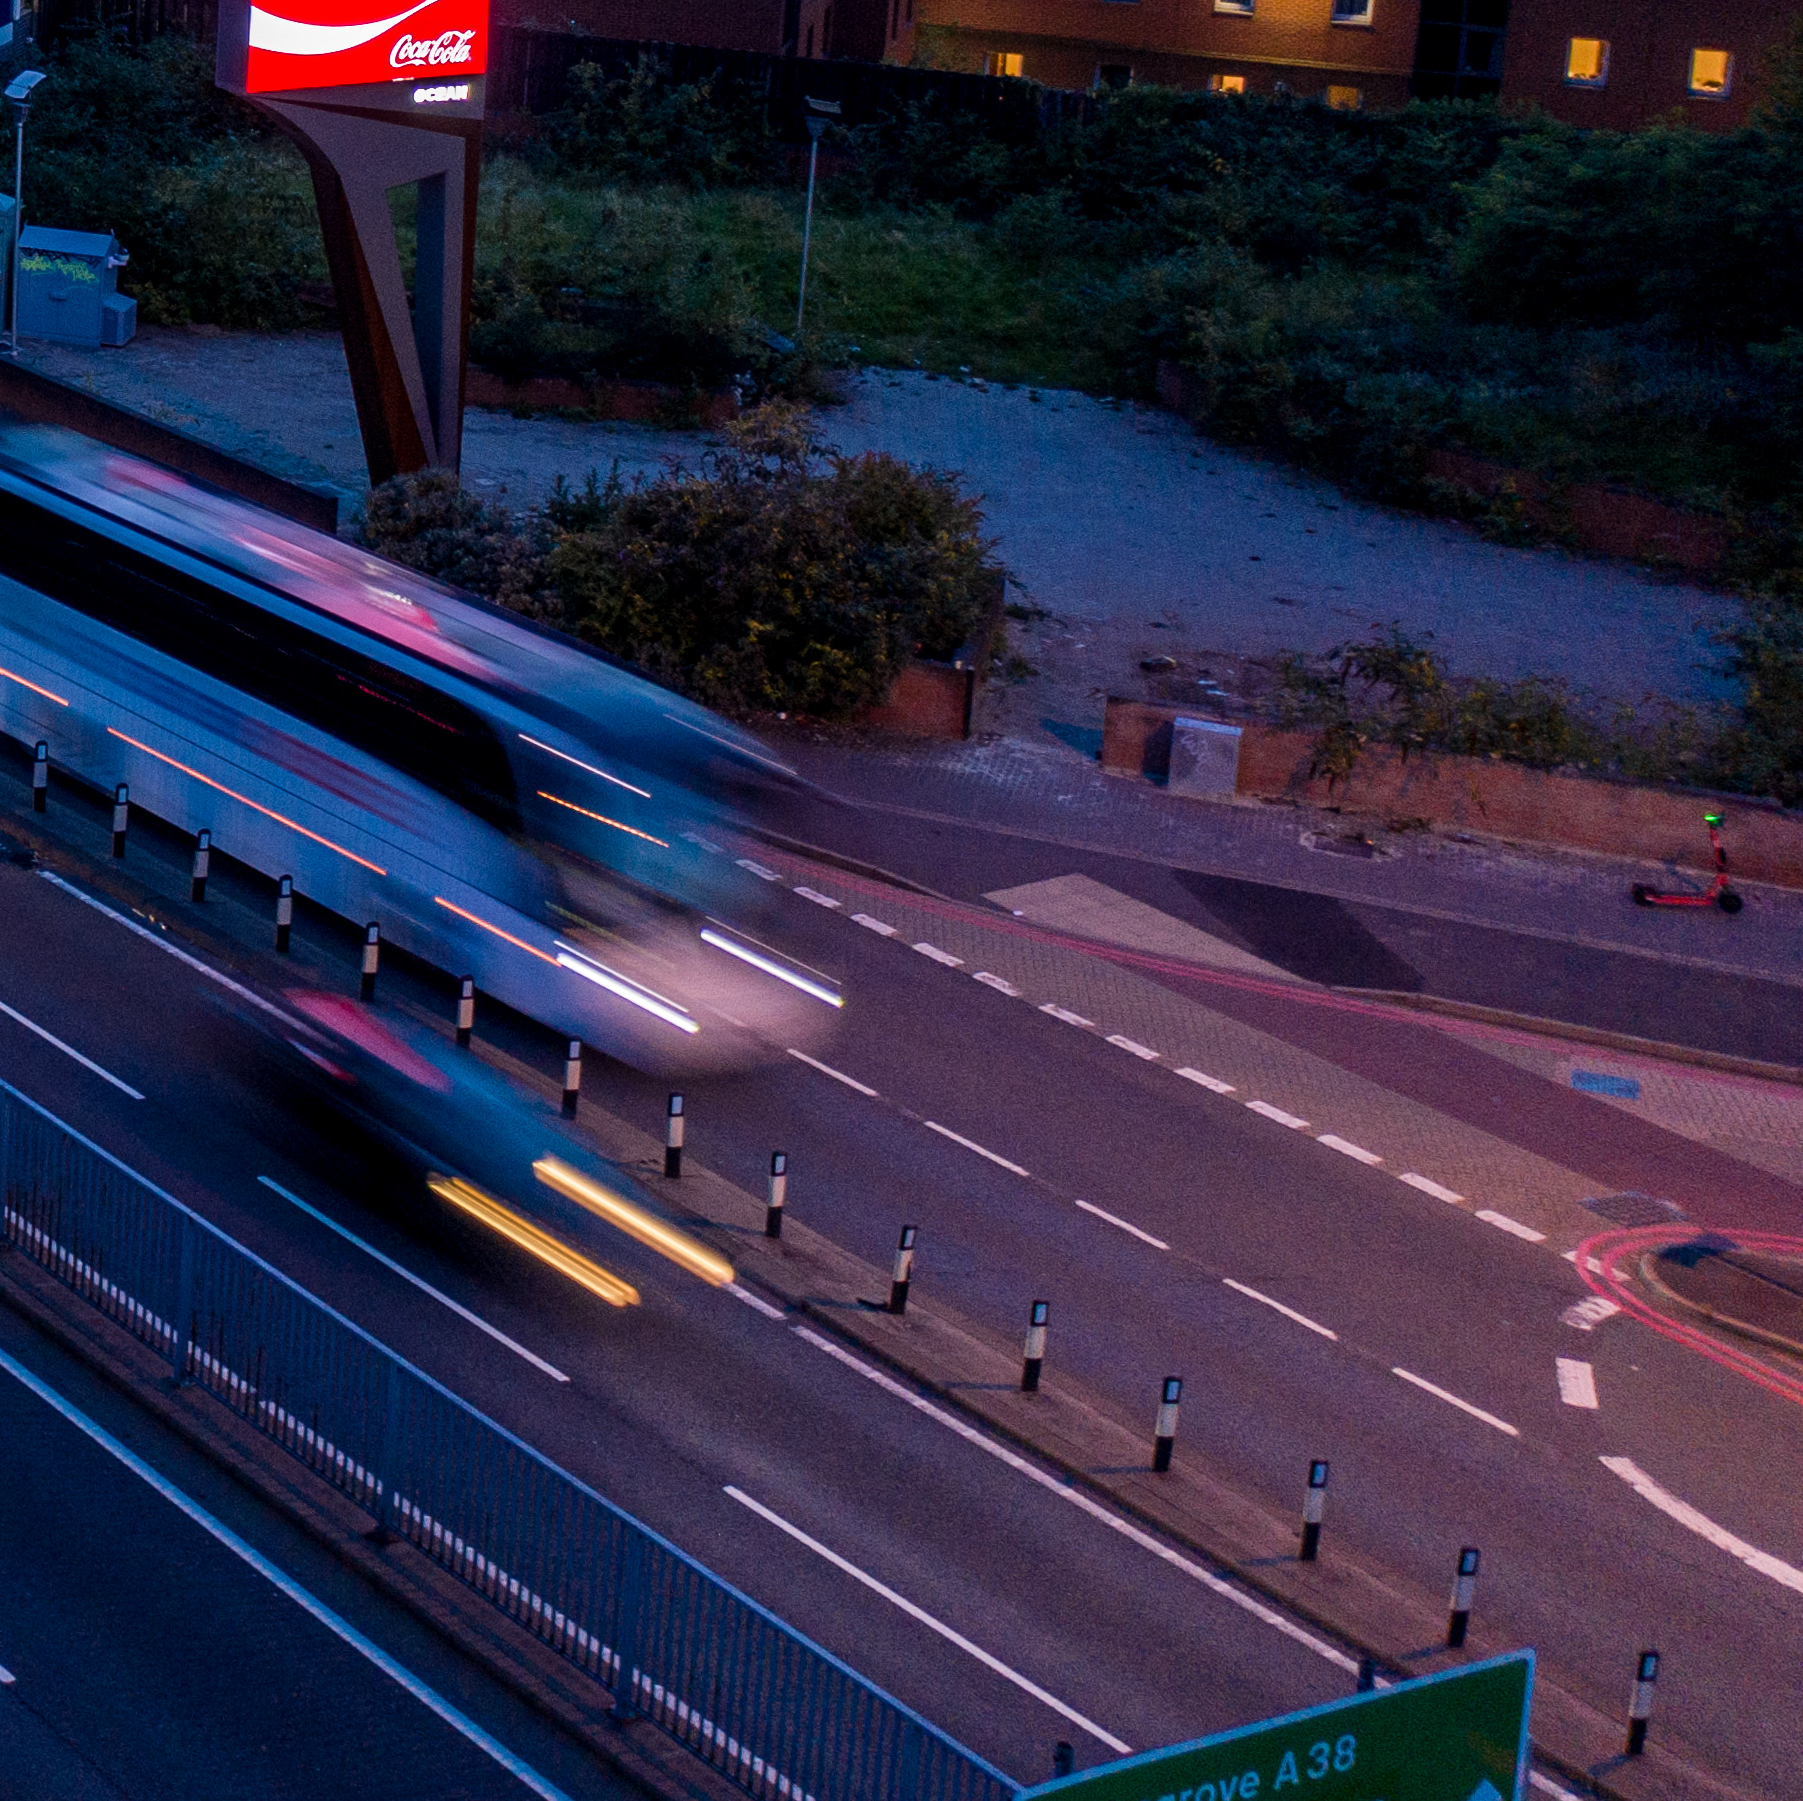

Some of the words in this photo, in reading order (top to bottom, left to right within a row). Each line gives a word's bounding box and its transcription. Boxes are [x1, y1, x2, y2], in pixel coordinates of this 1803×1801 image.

[390, 30, 476, 68] Coca-Cola
[414, 85, 469, 103] OCEAN
[1273, 1734, 1357, 1791] A38
